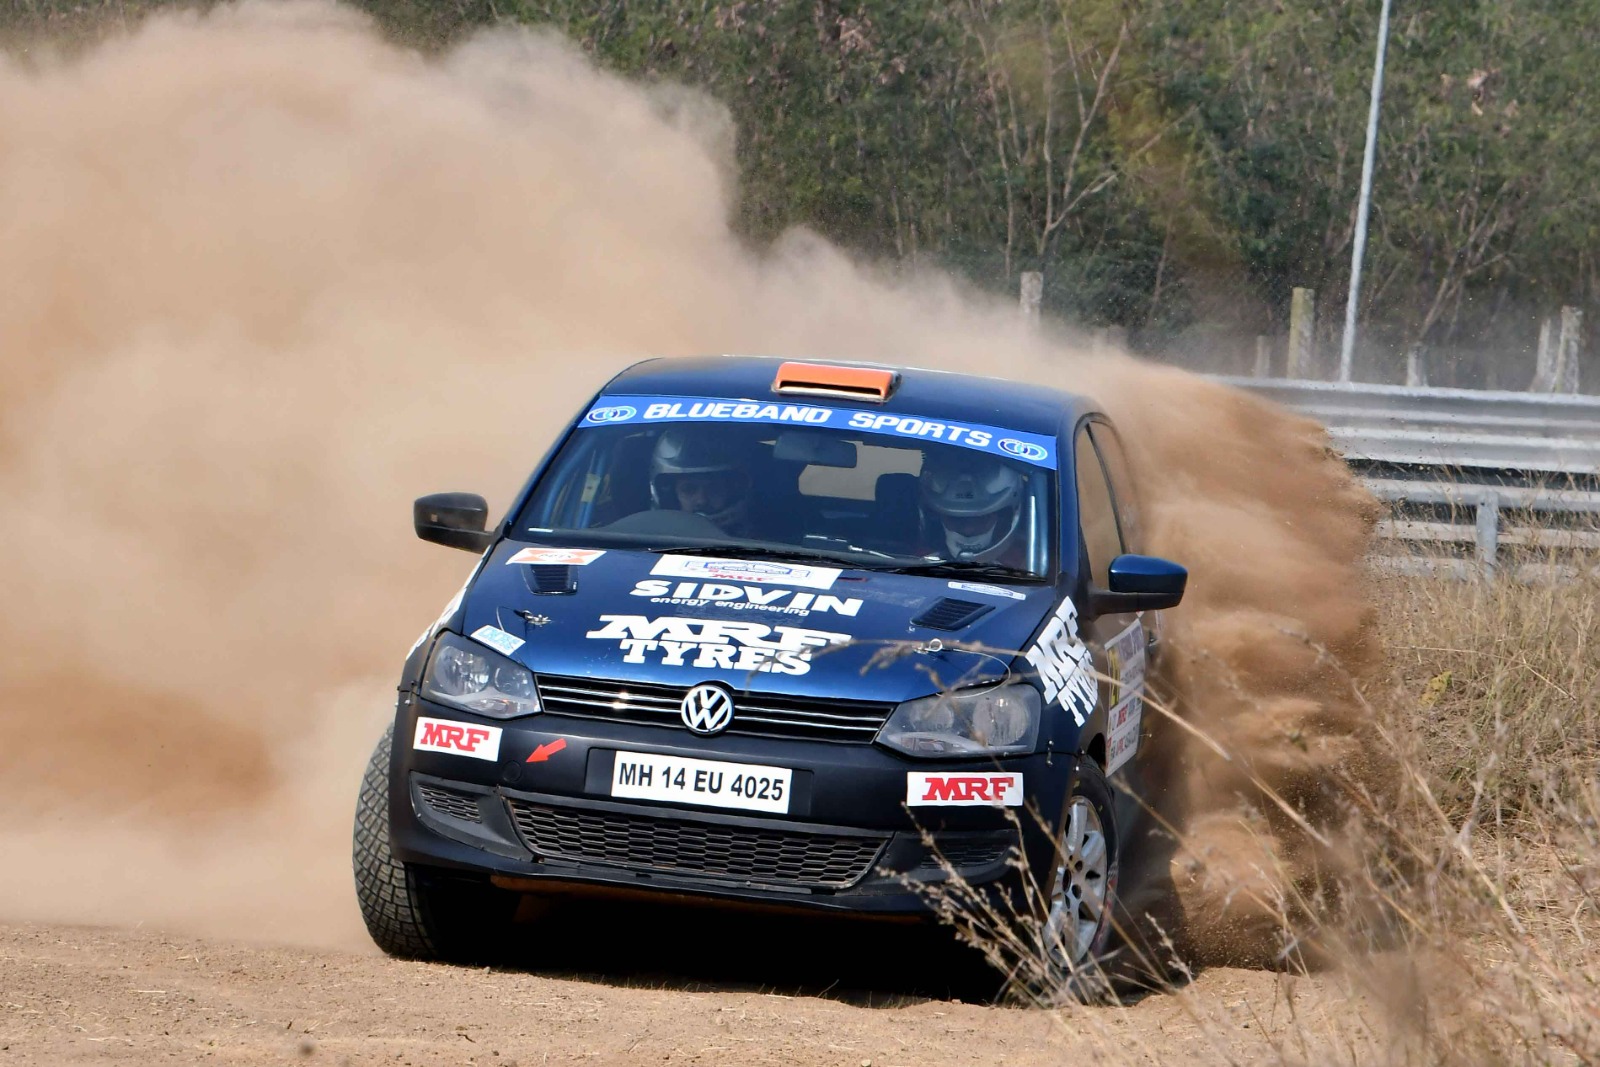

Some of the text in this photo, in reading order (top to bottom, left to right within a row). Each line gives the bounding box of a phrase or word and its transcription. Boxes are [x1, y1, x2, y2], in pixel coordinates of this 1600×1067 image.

[642, 402, 992, 446] BLUEBAND SPORTS
[629, 580, 864, 617] SIDVIN
[651, 597, 811, 617] energy engineering
[586, 615, 852, 651] MRF
[1025, 596, 1086, 704] MRF
[619, 639, 812, 676] TYRES
[420, 723, 490, 753] MRF
[619, 762, 784, 802] MH 14 EU 4025
[922, 777, 1014, 801] MRF
